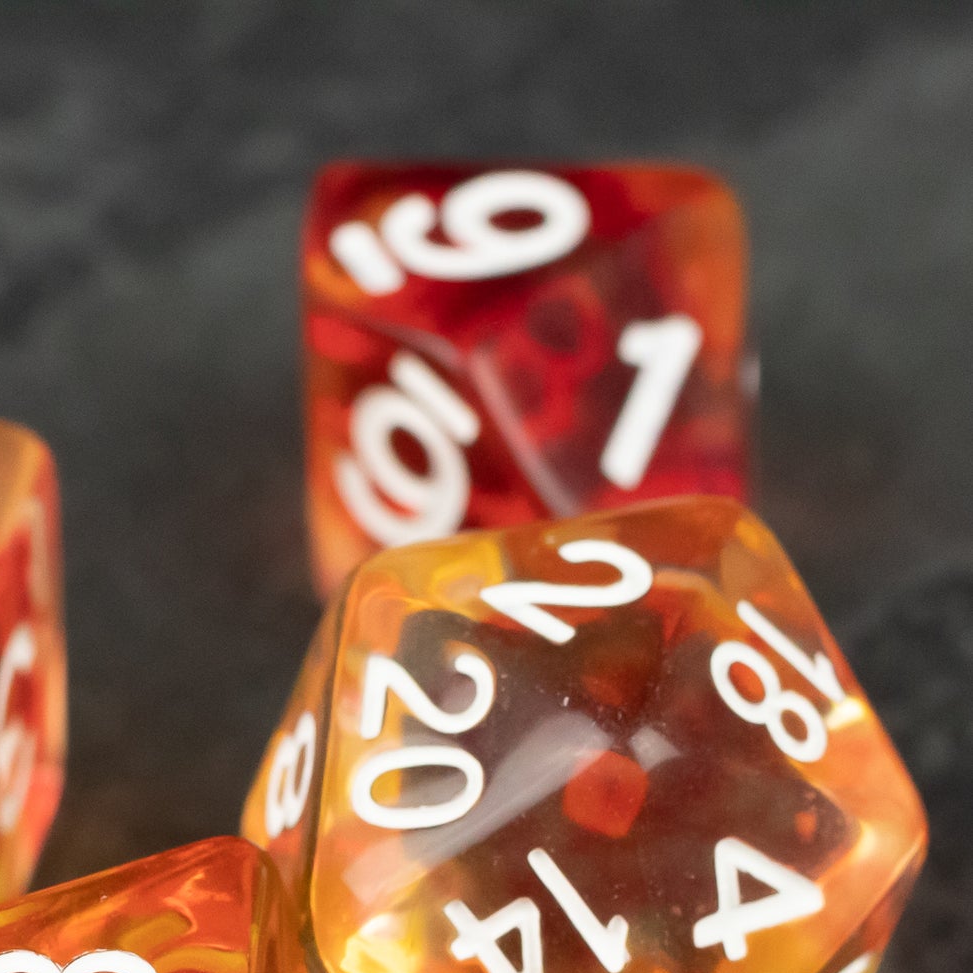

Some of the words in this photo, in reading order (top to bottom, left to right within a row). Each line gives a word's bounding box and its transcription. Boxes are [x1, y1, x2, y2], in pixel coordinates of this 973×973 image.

[600, 314, 703, 490] 1
[480, 539, 653, 644] 2
[351, 654, 496, 830] 20
[710, 598, 847, 763] 18
[264, 711, 316, 838] 8
[693, 838, 825, 960] 4
